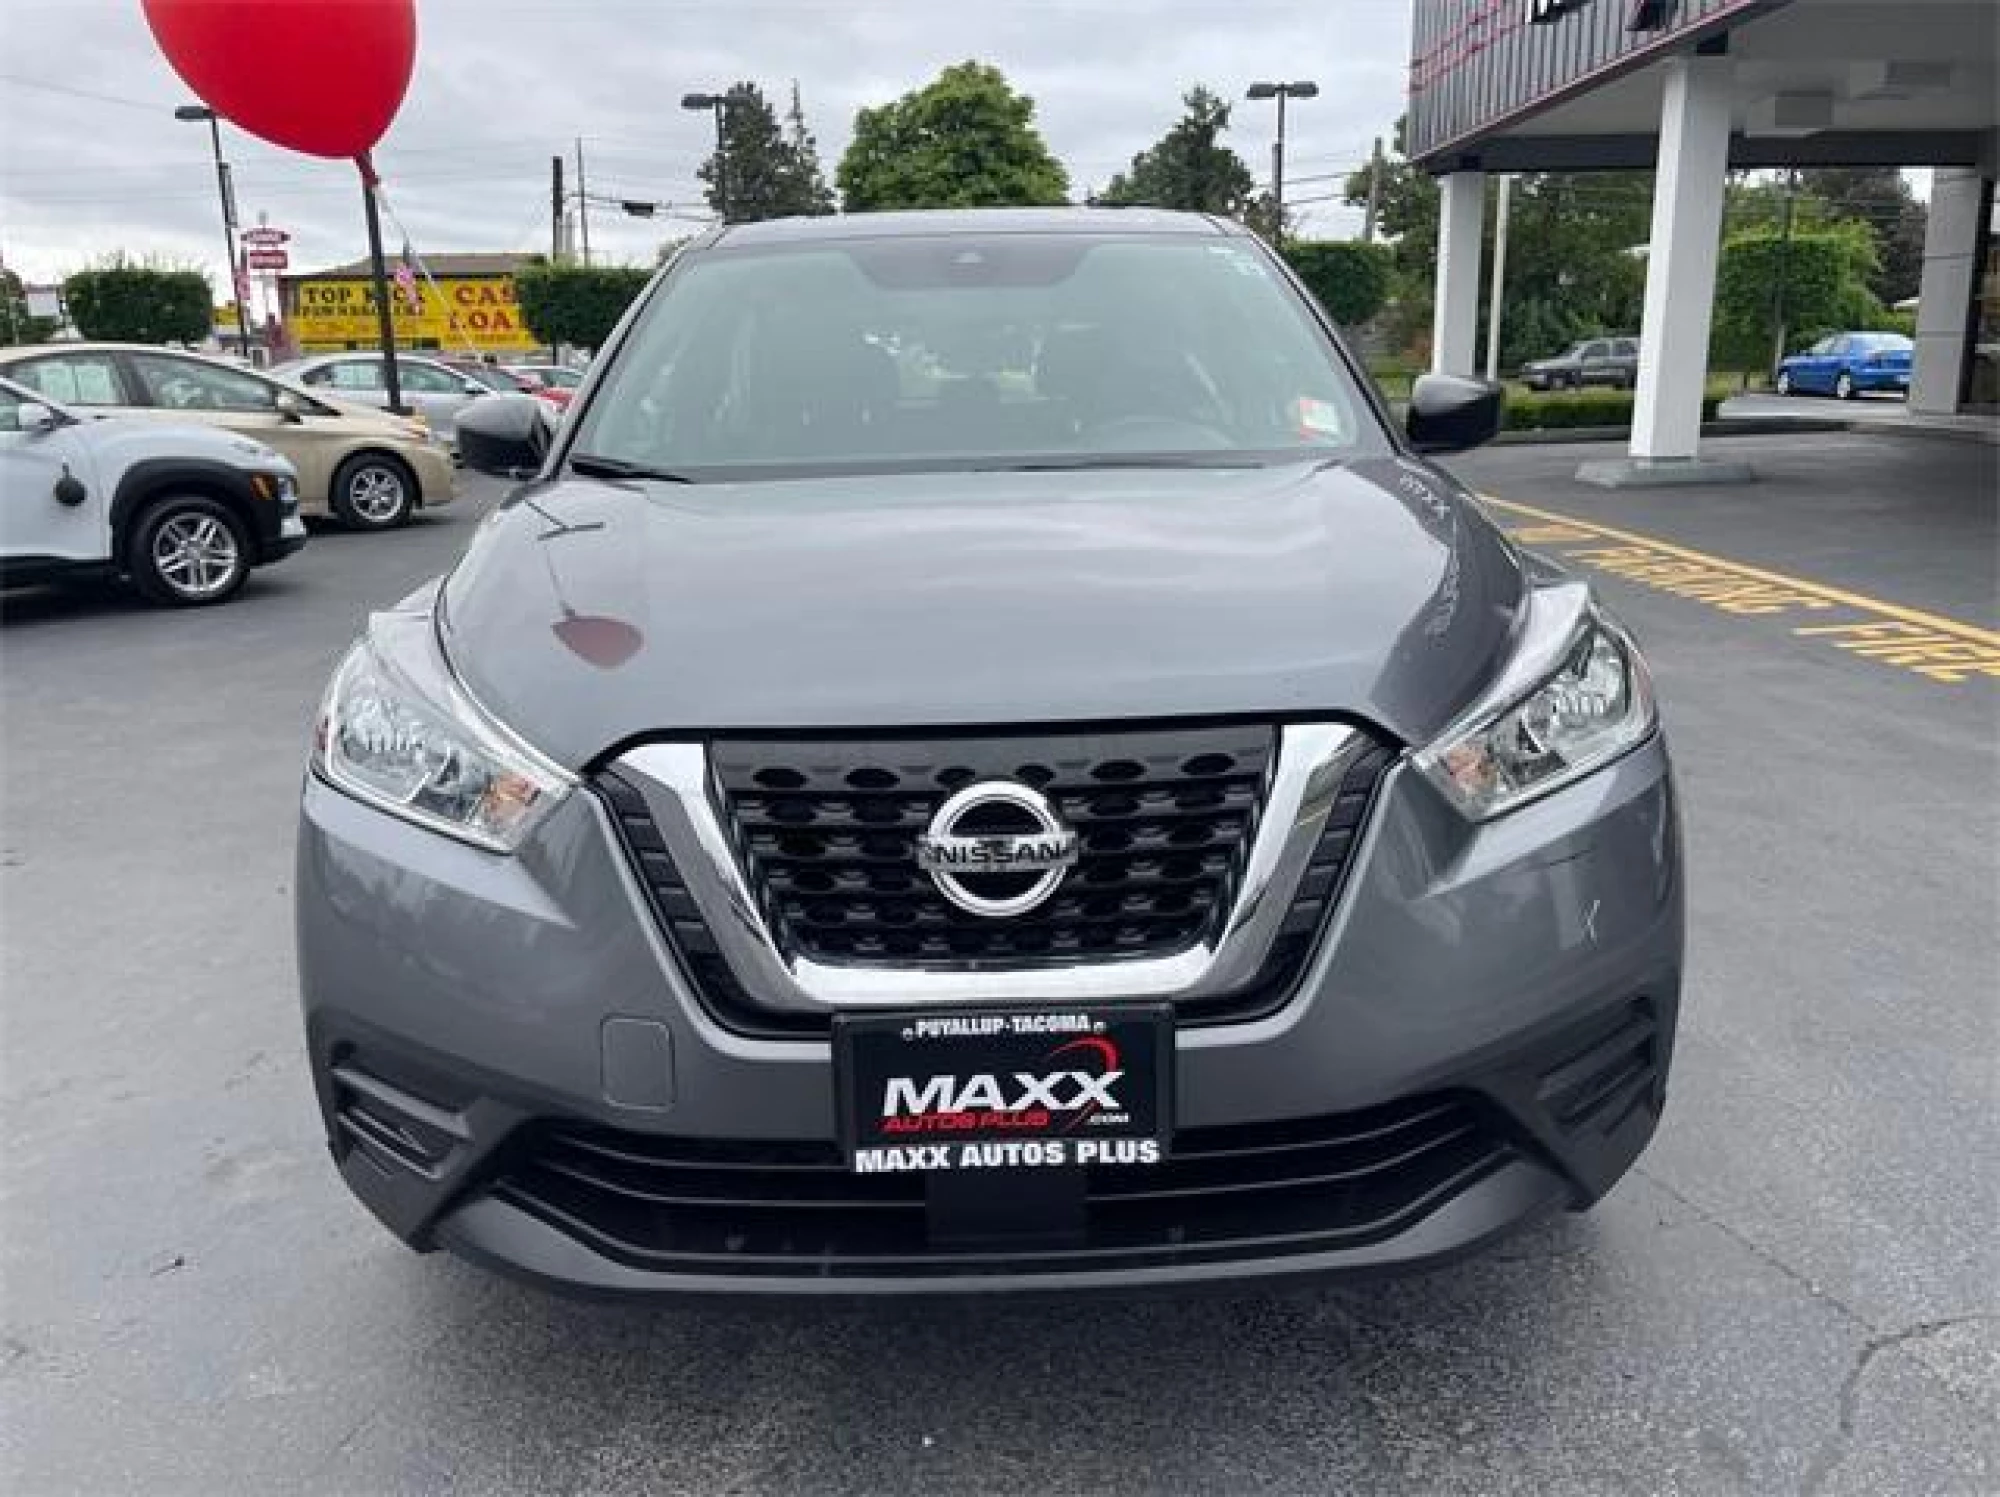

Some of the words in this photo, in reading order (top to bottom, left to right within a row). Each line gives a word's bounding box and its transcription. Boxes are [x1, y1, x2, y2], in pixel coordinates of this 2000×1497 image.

[304, 286, 352, 304] TOP
[455, 284, 517, 306] CAS
[448, 309, 513, 331] LOA
[933, 842, 1062, 864] NISSAN
[882, 1069, 1125, 1117] MAXX
[880, 1111, 976, 1132] AUTOS
[980, 1109, 1049, 1128] PLUS
[855, 1146, 950, 1172] MAXX
[958, 1142, 1067, 1167] AUTOS
[1076, 1139, 1161, 1164] PLUS
